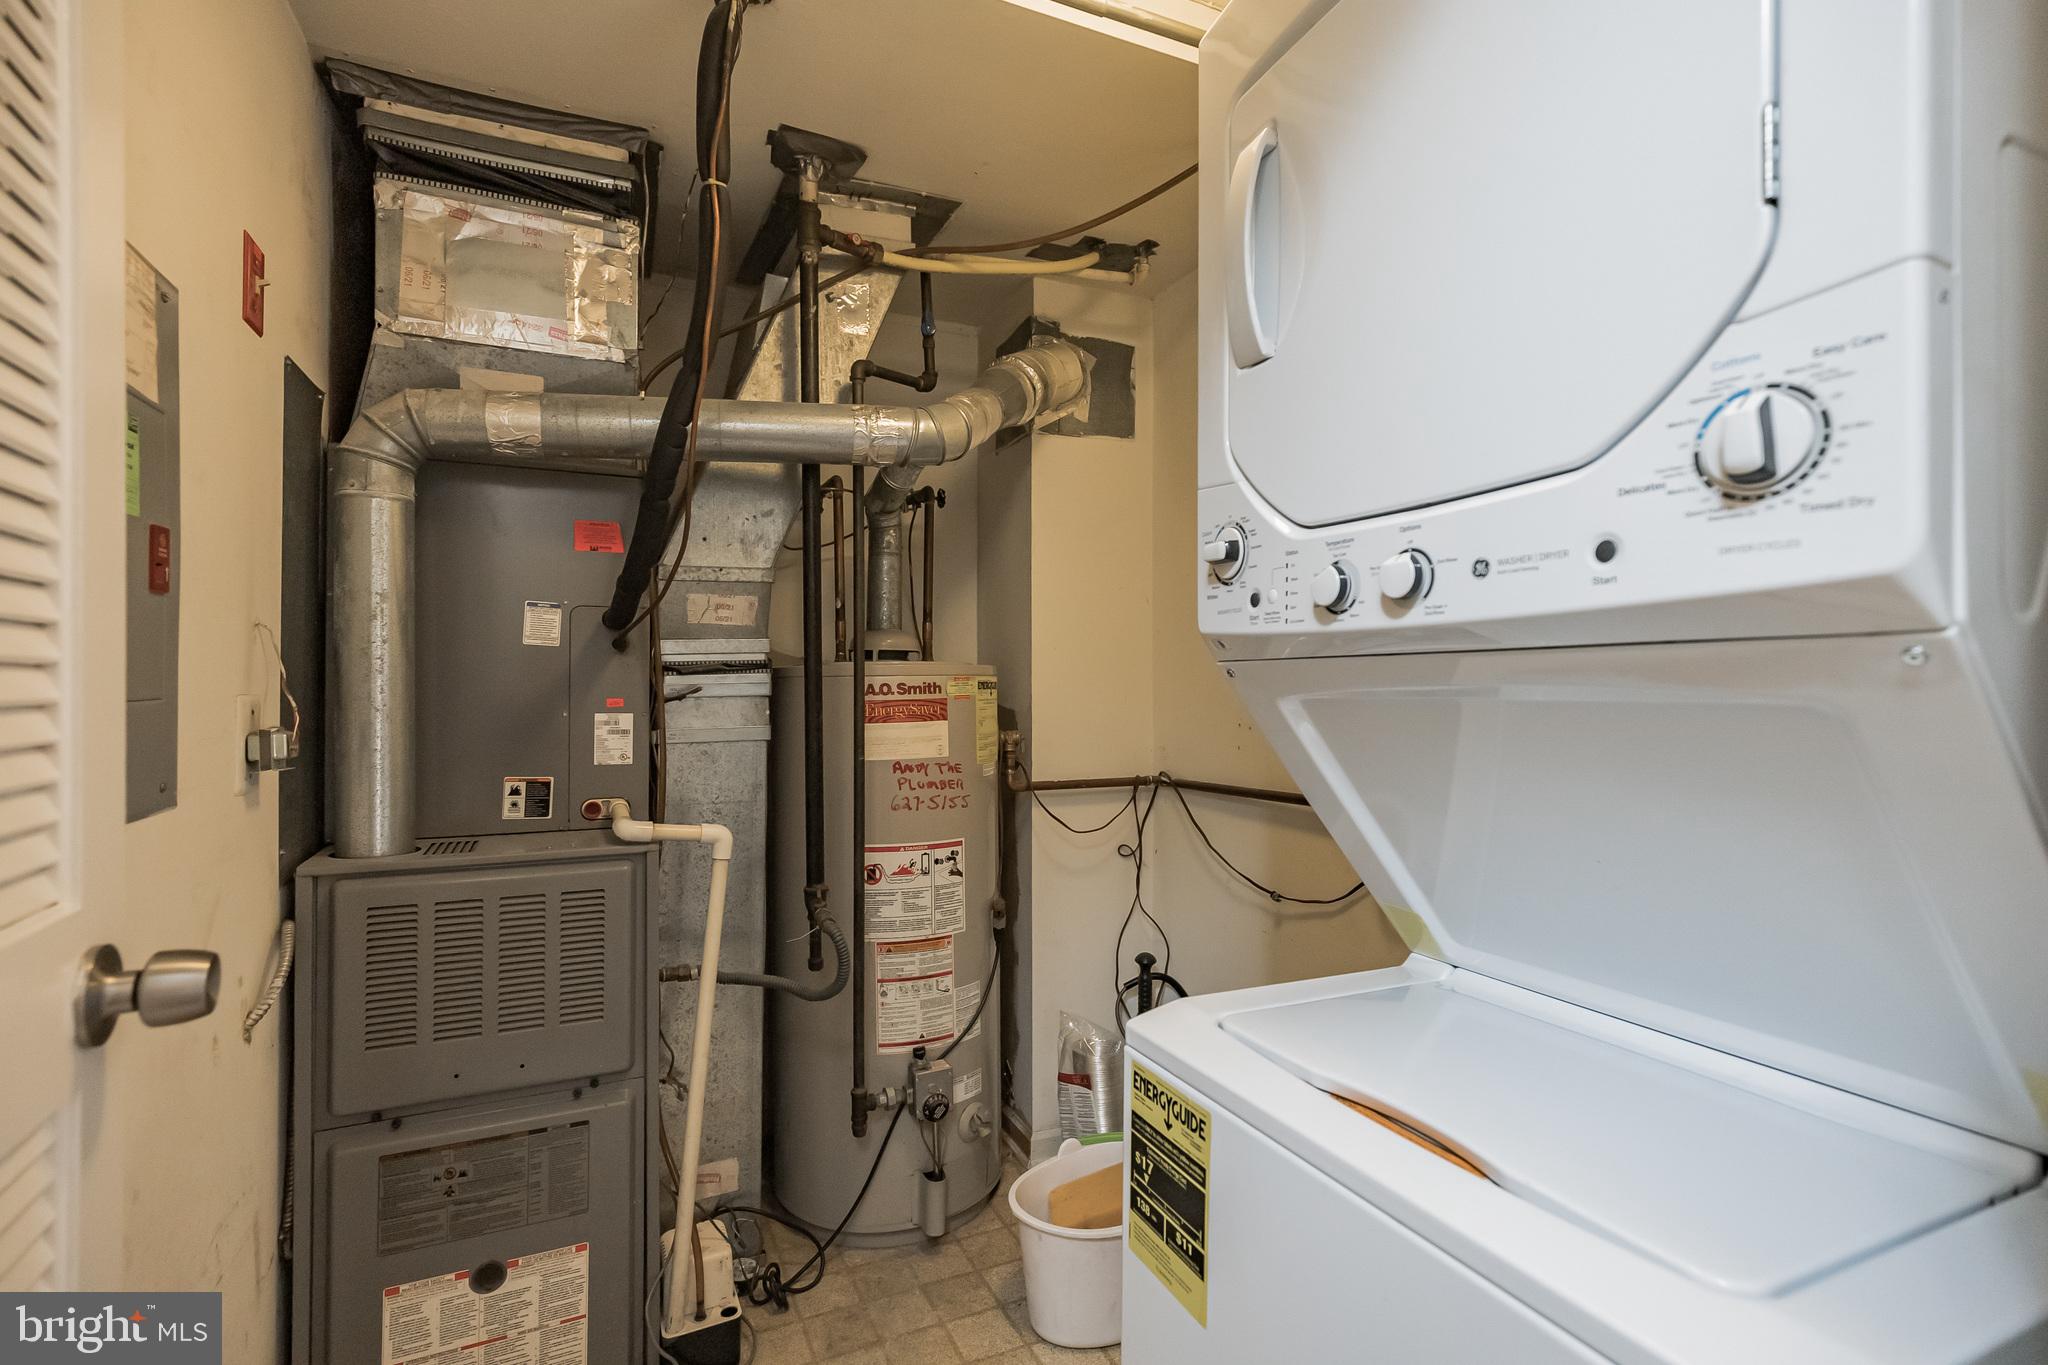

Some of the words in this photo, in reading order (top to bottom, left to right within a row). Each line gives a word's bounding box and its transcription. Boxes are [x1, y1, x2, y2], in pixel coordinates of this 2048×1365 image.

[1593, 575, 1617, 586] Start
[865, 682, 895, 697] A.O.
[896, 682, 942, 695] Smith
[890, 795, 971, 811] 627-5155
[1133, 1070, 1207, 1142] ENERGYGUIDE
[1135, 1151, 1154, 1175] $17
[1175, 1231, 1193, 1256] $11
